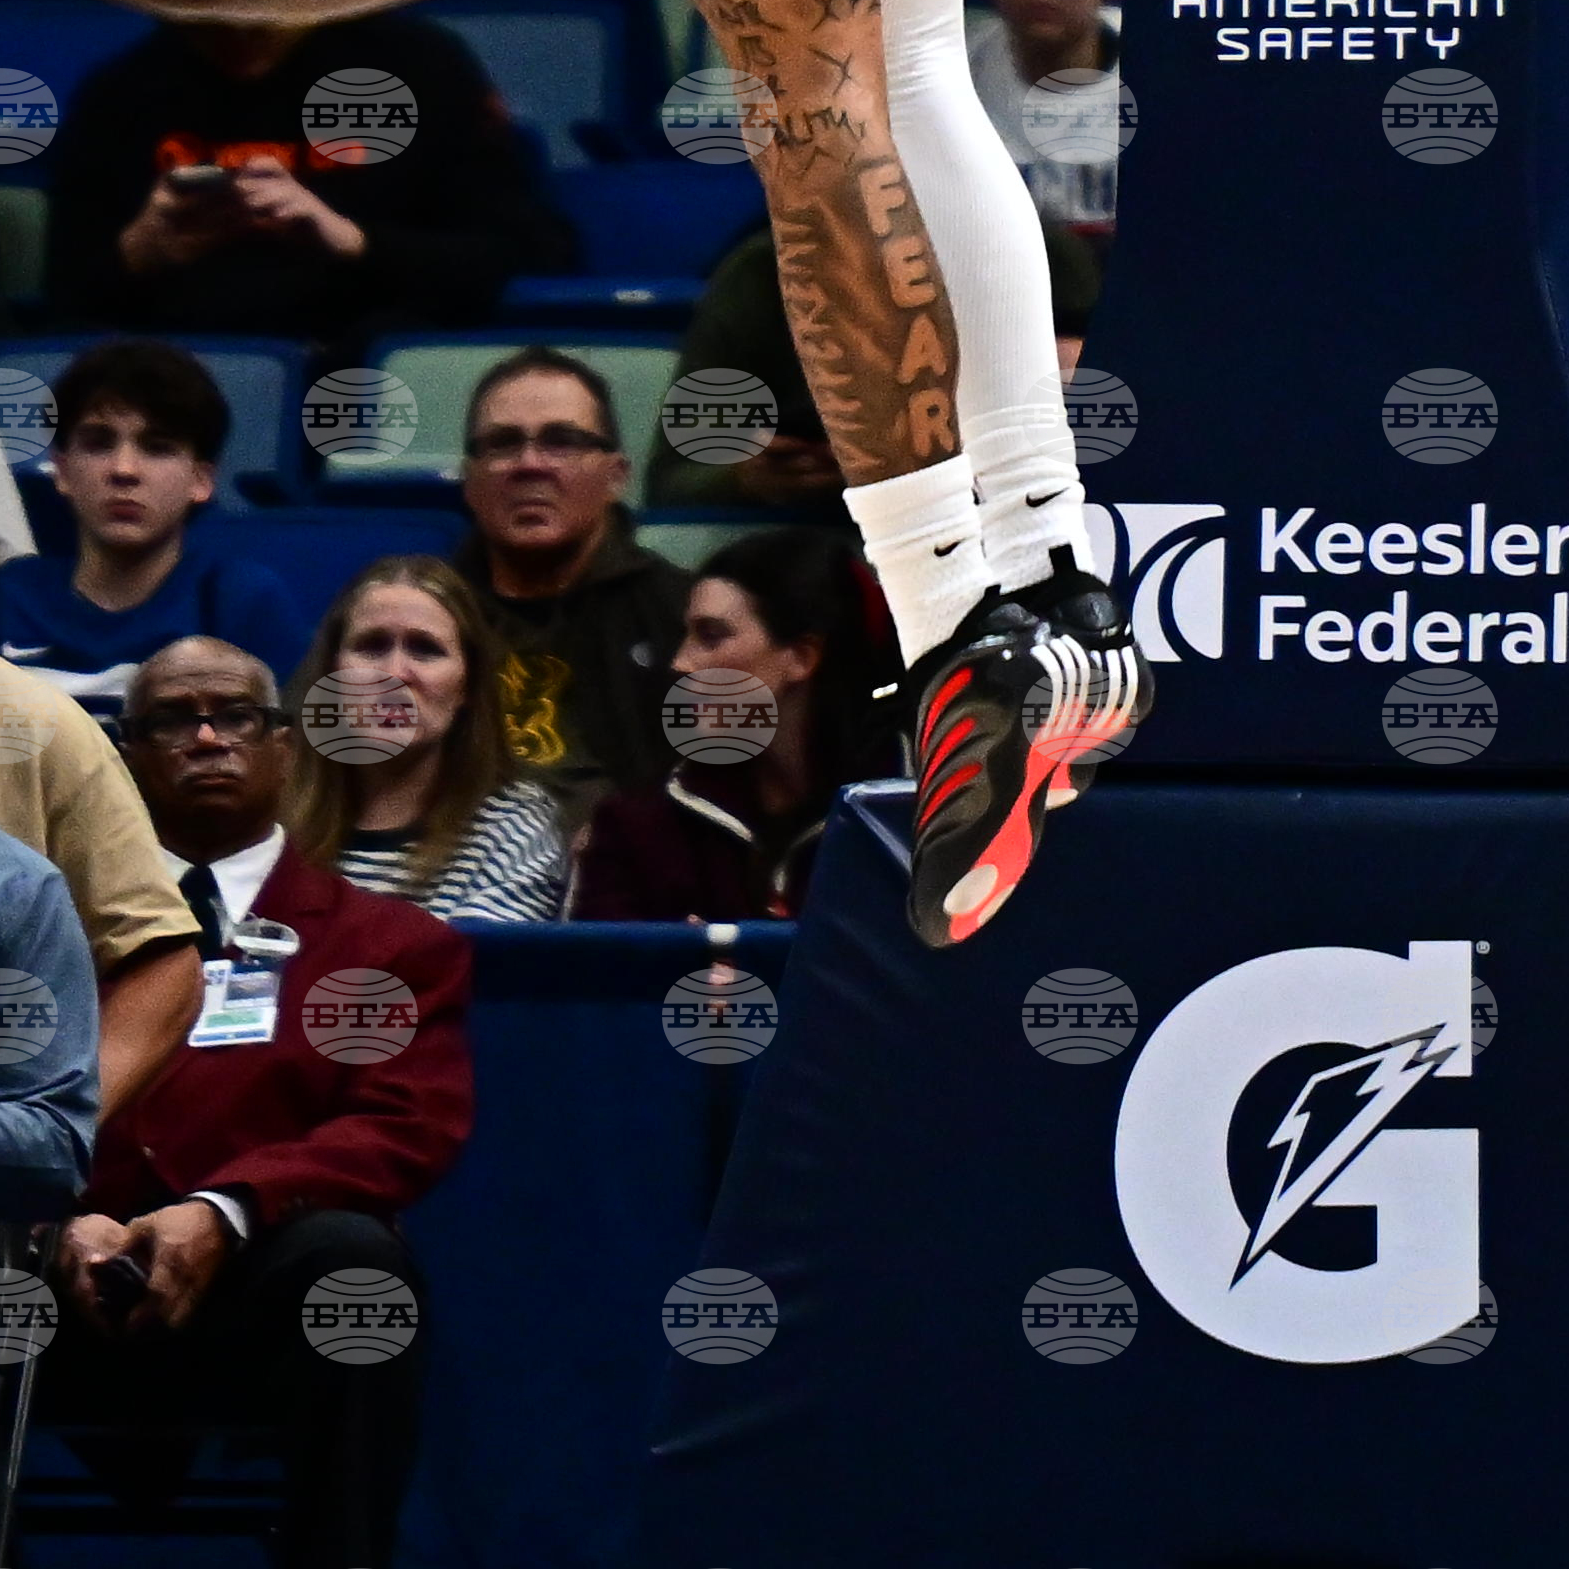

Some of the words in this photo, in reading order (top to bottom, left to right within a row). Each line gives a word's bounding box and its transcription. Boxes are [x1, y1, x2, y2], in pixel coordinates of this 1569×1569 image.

[1216, 26, 1460, 61] SAFETY
[1260, 502, 1569, 577] Keesler
[1258, 590, 1569, 665] Federal
[1114, 940, 1480, 1364] G
